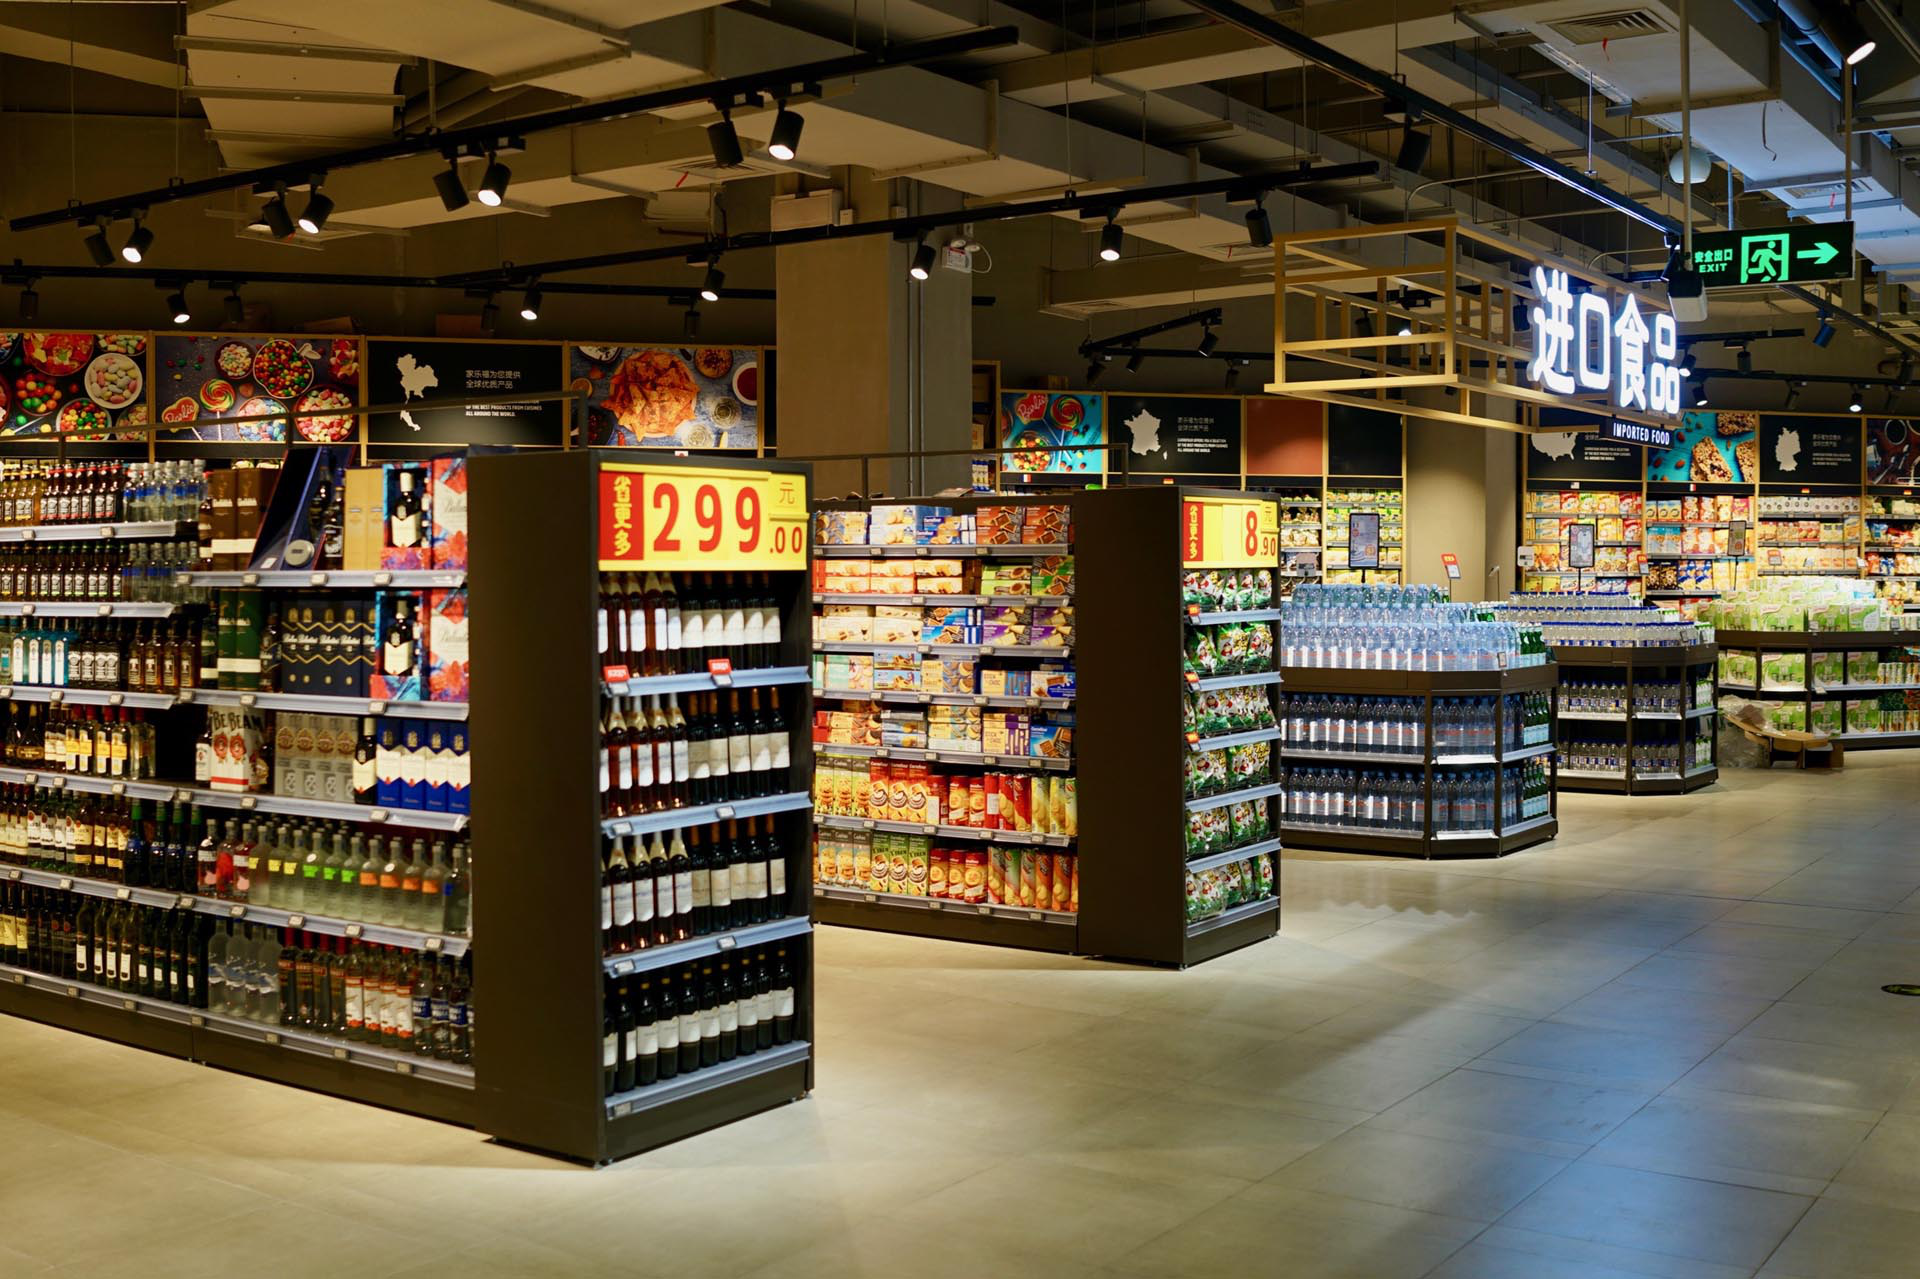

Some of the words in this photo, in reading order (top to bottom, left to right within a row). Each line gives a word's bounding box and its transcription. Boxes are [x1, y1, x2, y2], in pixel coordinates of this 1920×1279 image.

[1695, 249, 1733, 264] 安全出口
[1699, 263, 1728, 273] EXIT
[1528, 265, 1681, 415] 进口食品
[1612, 422, 1650, 443] IMPORTED
[1651, 429, 1671, 447] FOOD
[778, 481, 796, 506] 元
[613, 475, 633, 557] 省更多
[652, 482, 761, 553] 299
[1245, 510, 1258, 557] 8
[1261, 536, 1277, 557] .90
